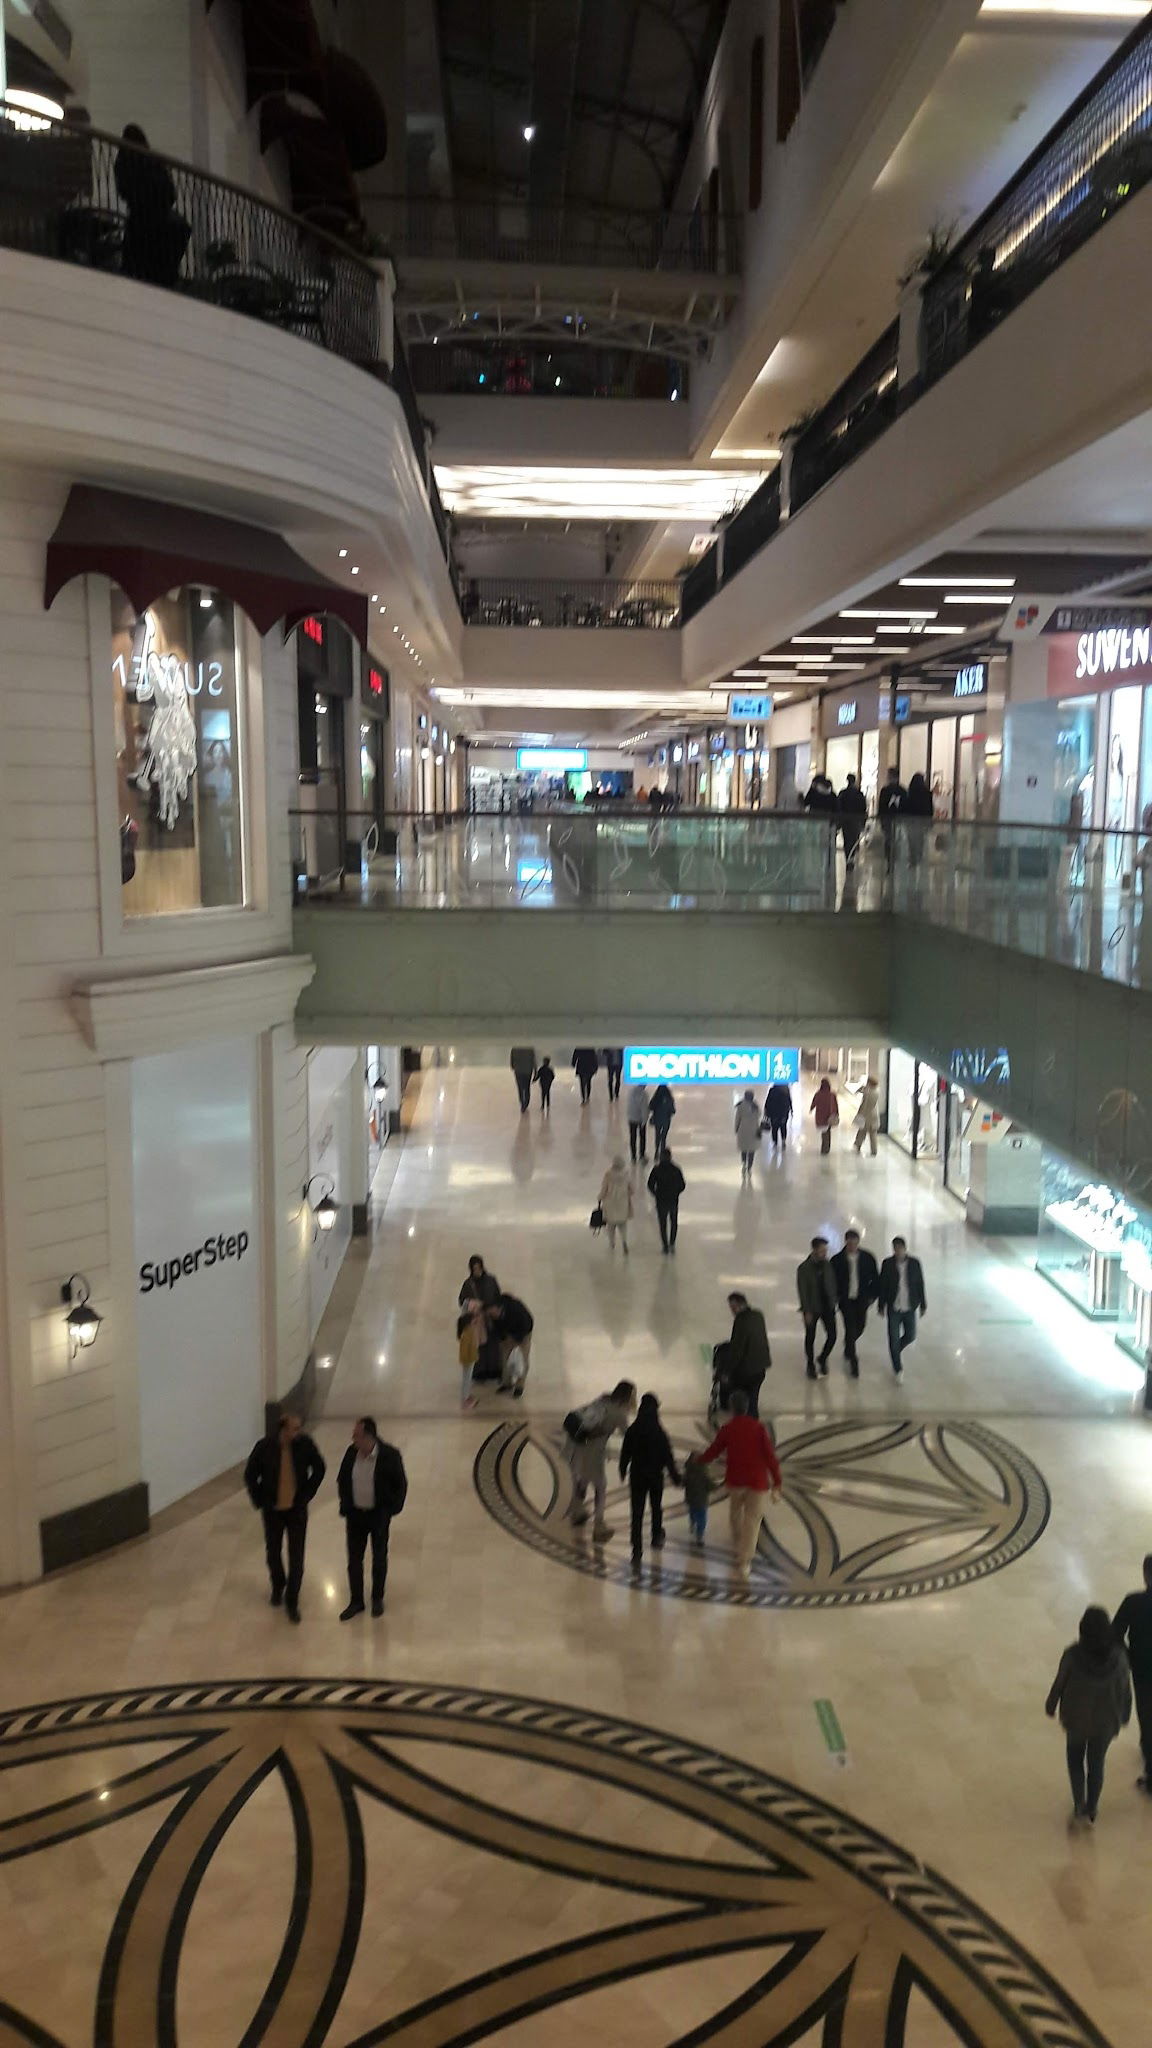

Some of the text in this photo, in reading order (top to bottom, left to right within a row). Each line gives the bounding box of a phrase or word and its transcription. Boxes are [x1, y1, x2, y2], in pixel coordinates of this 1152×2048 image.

[1076, 627, 1150, 678] SUWEN
[631, 1053, 761, 1079] DECATHLON
[140, 1229, 249, 1293] SuperStep
